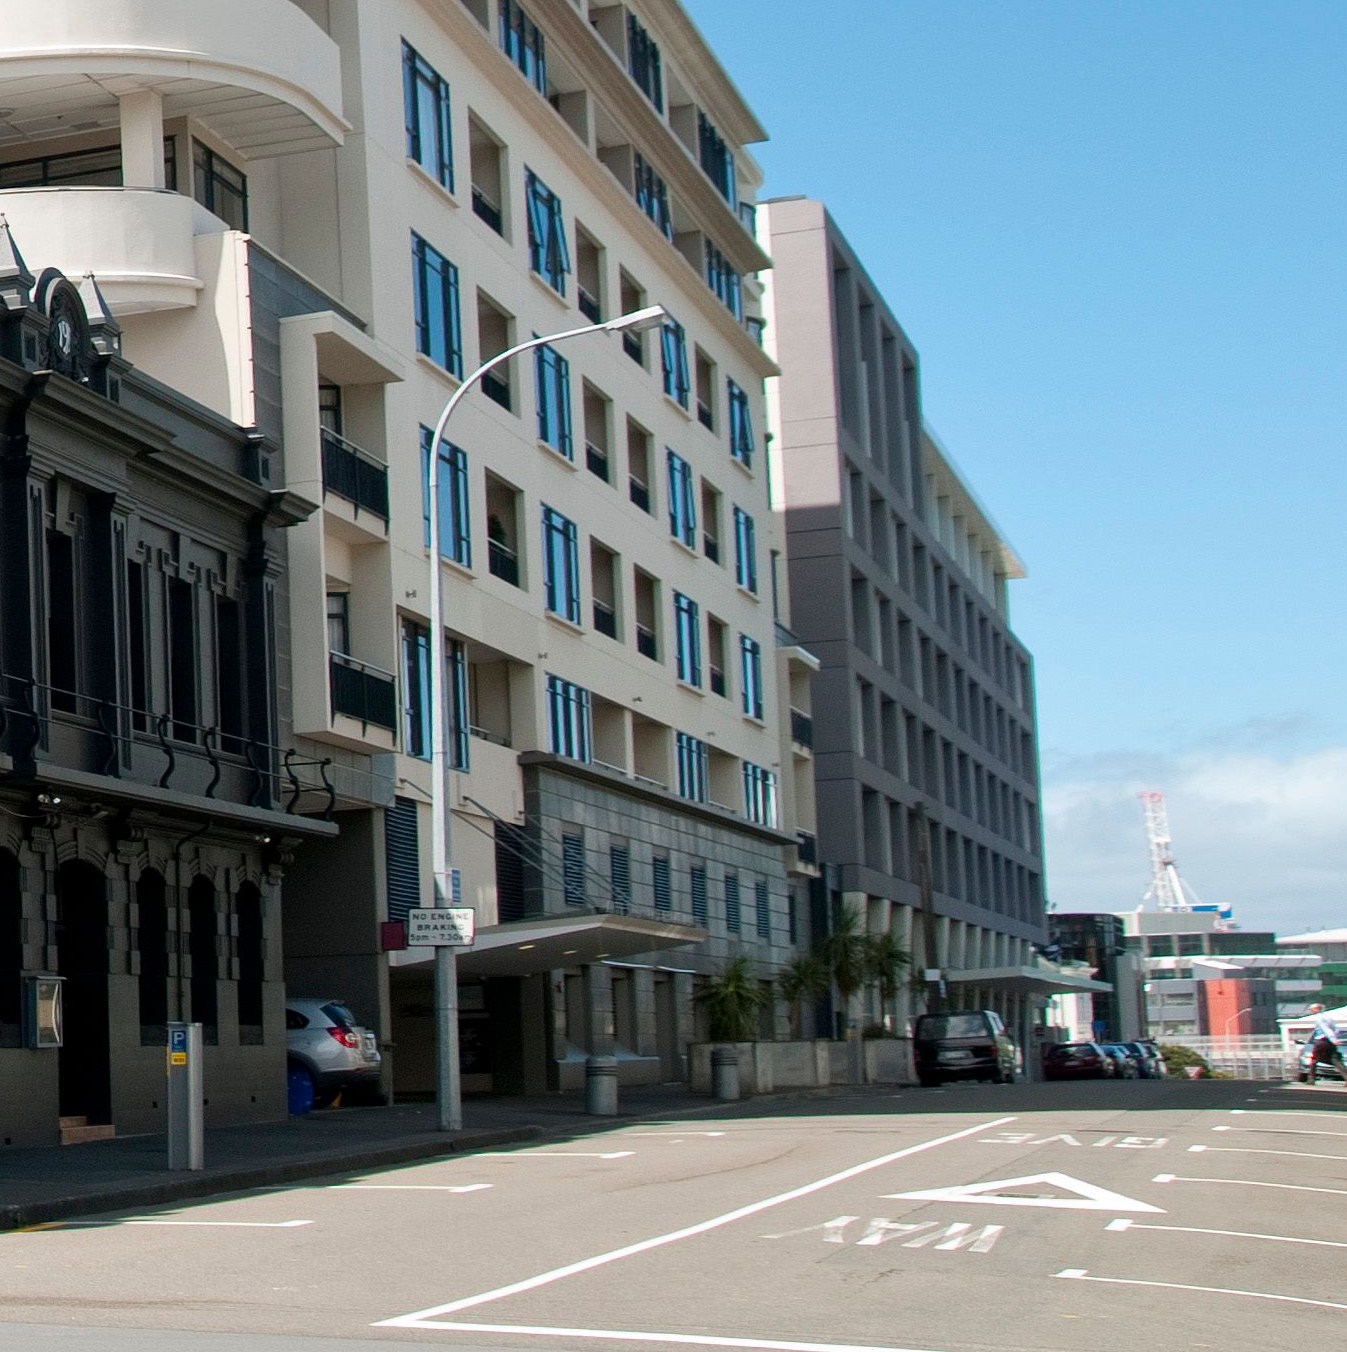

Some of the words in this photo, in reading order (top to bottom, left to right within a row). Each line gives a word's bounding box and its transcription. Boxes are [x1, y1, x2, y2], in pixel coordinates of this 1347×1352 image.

[412, 913, 427, 921] NO
[431, 913, 470, 921] ENGINE
[174, 1032, 185, 1044] P
